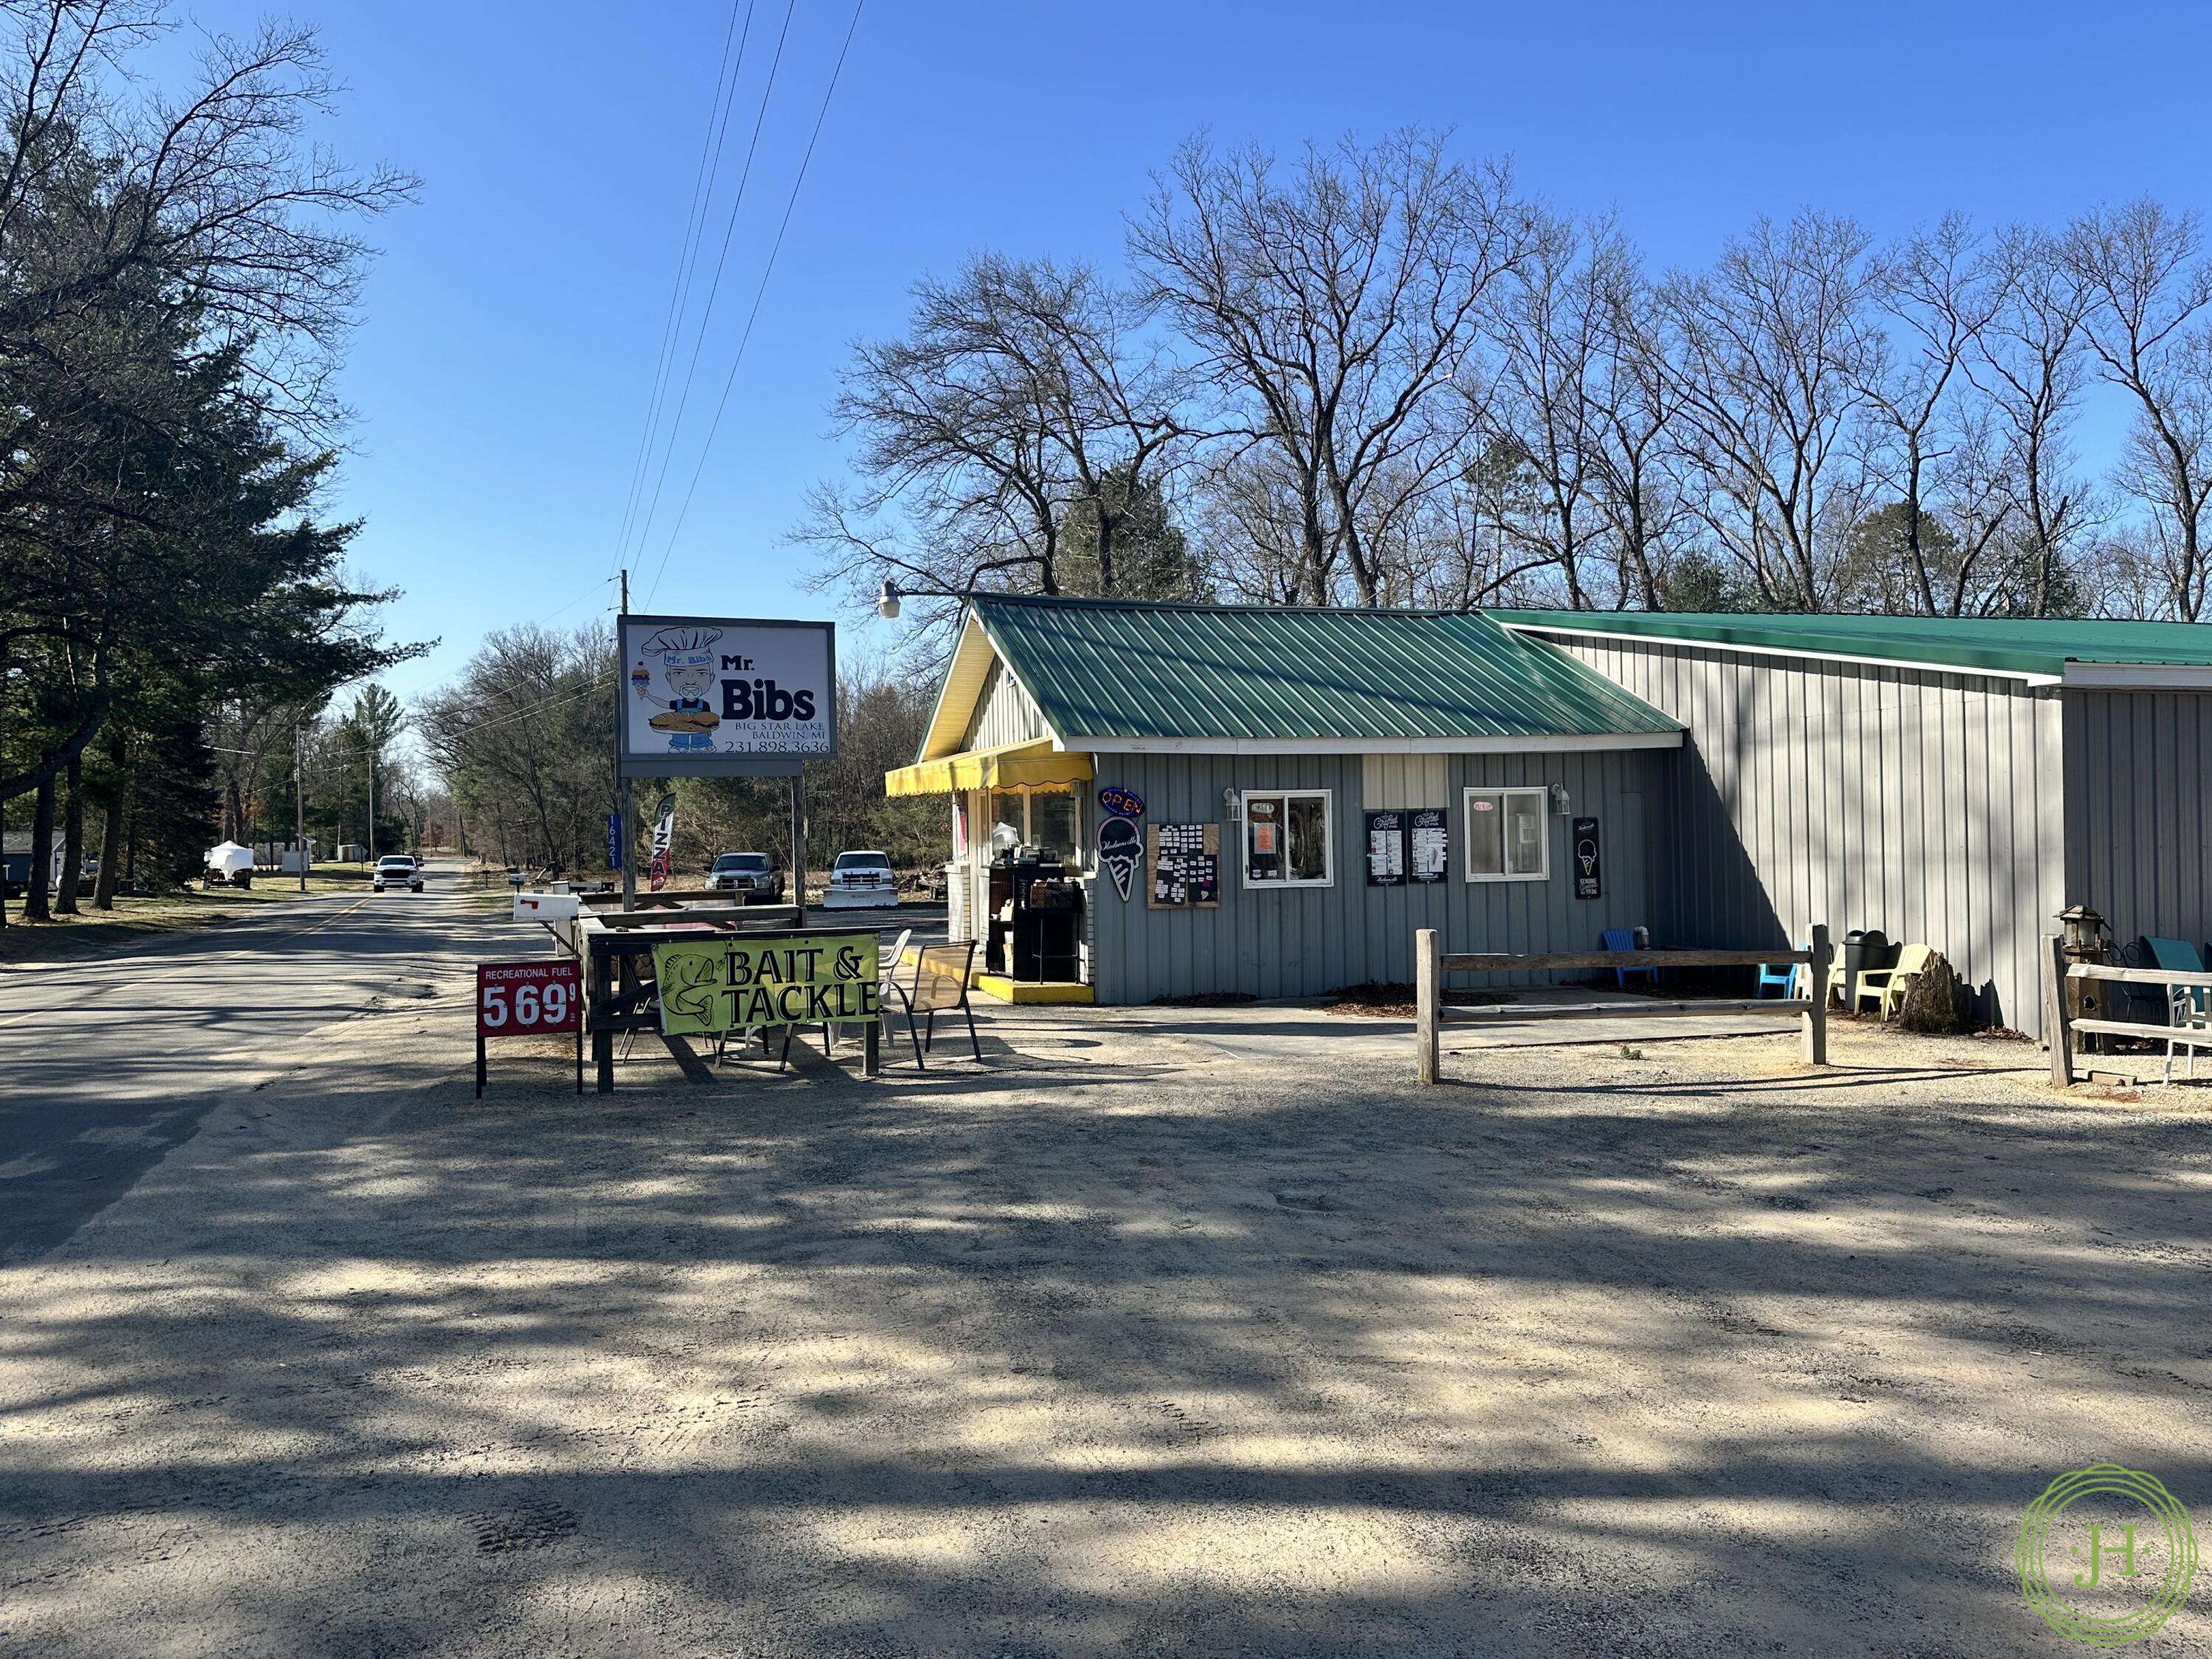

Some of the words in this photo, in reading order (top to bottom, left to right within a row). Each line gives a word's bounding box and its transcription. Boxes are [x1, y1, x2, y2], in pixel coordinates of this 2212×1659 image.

[720, 655, 755, 671] Mr.
[720, 678, 815, 721] Bibs
[735, 722, 757, 731] BIG
[761, 722, 791, 731] STAR
[796, 722, 825, 731] LAKE
[812, 731, 825, 740] MI
[725, 741, 830, 754] 231.898.3636
[1102, 792, 1142, 814] OPEN
[608, 815, 616, 867] 16421
[652, 803, 672, 875] PIZZA
[1101, 836, 1136, 851] Hudsonville
[485, 968, 549, 980] RECREATIONAL
[552, 967, 573, 976] FUEL
[724, 948, 824, 986] BAIT
[832, 946, 864, 981] &
[721, 981, 879, 1023] TACKLE
